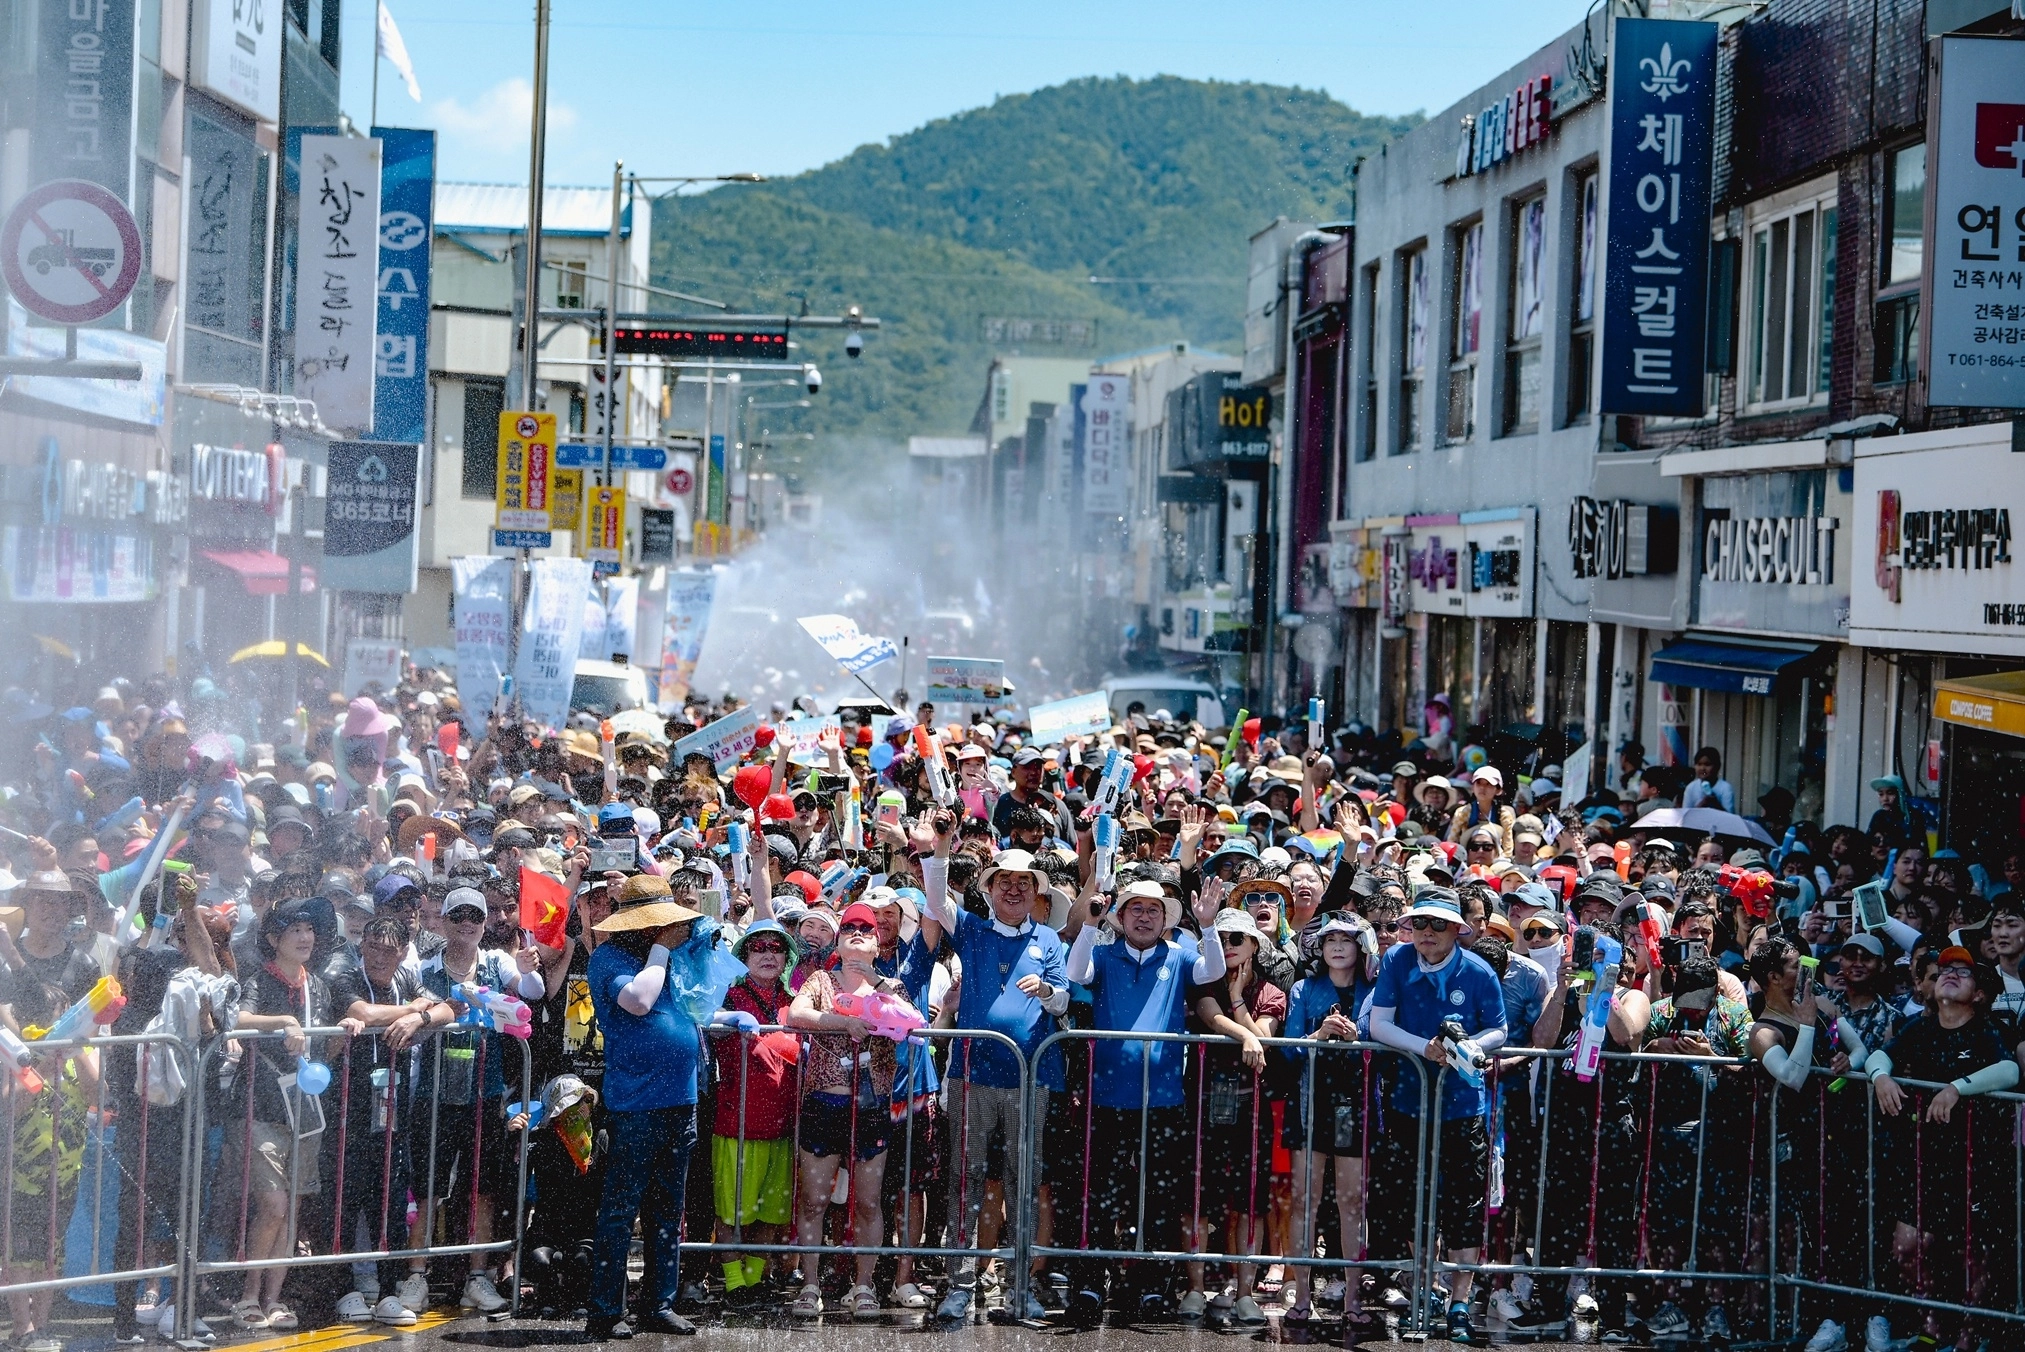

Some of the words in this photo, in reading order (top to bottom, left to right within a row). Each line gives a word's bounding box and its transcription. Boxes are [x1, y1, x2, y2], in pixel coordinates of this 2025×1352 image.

[1957, 204, 2025, 262] 연
[1627, 114, 1683, 394] 체이스컬트
[1953, 270, 2022, 290] 건축사사
[1948, 353, 1957, 365] T
[1218, 396, 1265, 427] Hof
[331, 501, 412, 524] 365코너
[1662, 704, 1687, 723] ON
[1950, 700, 1974, 718] COMPOSE
[1973, 704, 1994, 722] COFFEE
